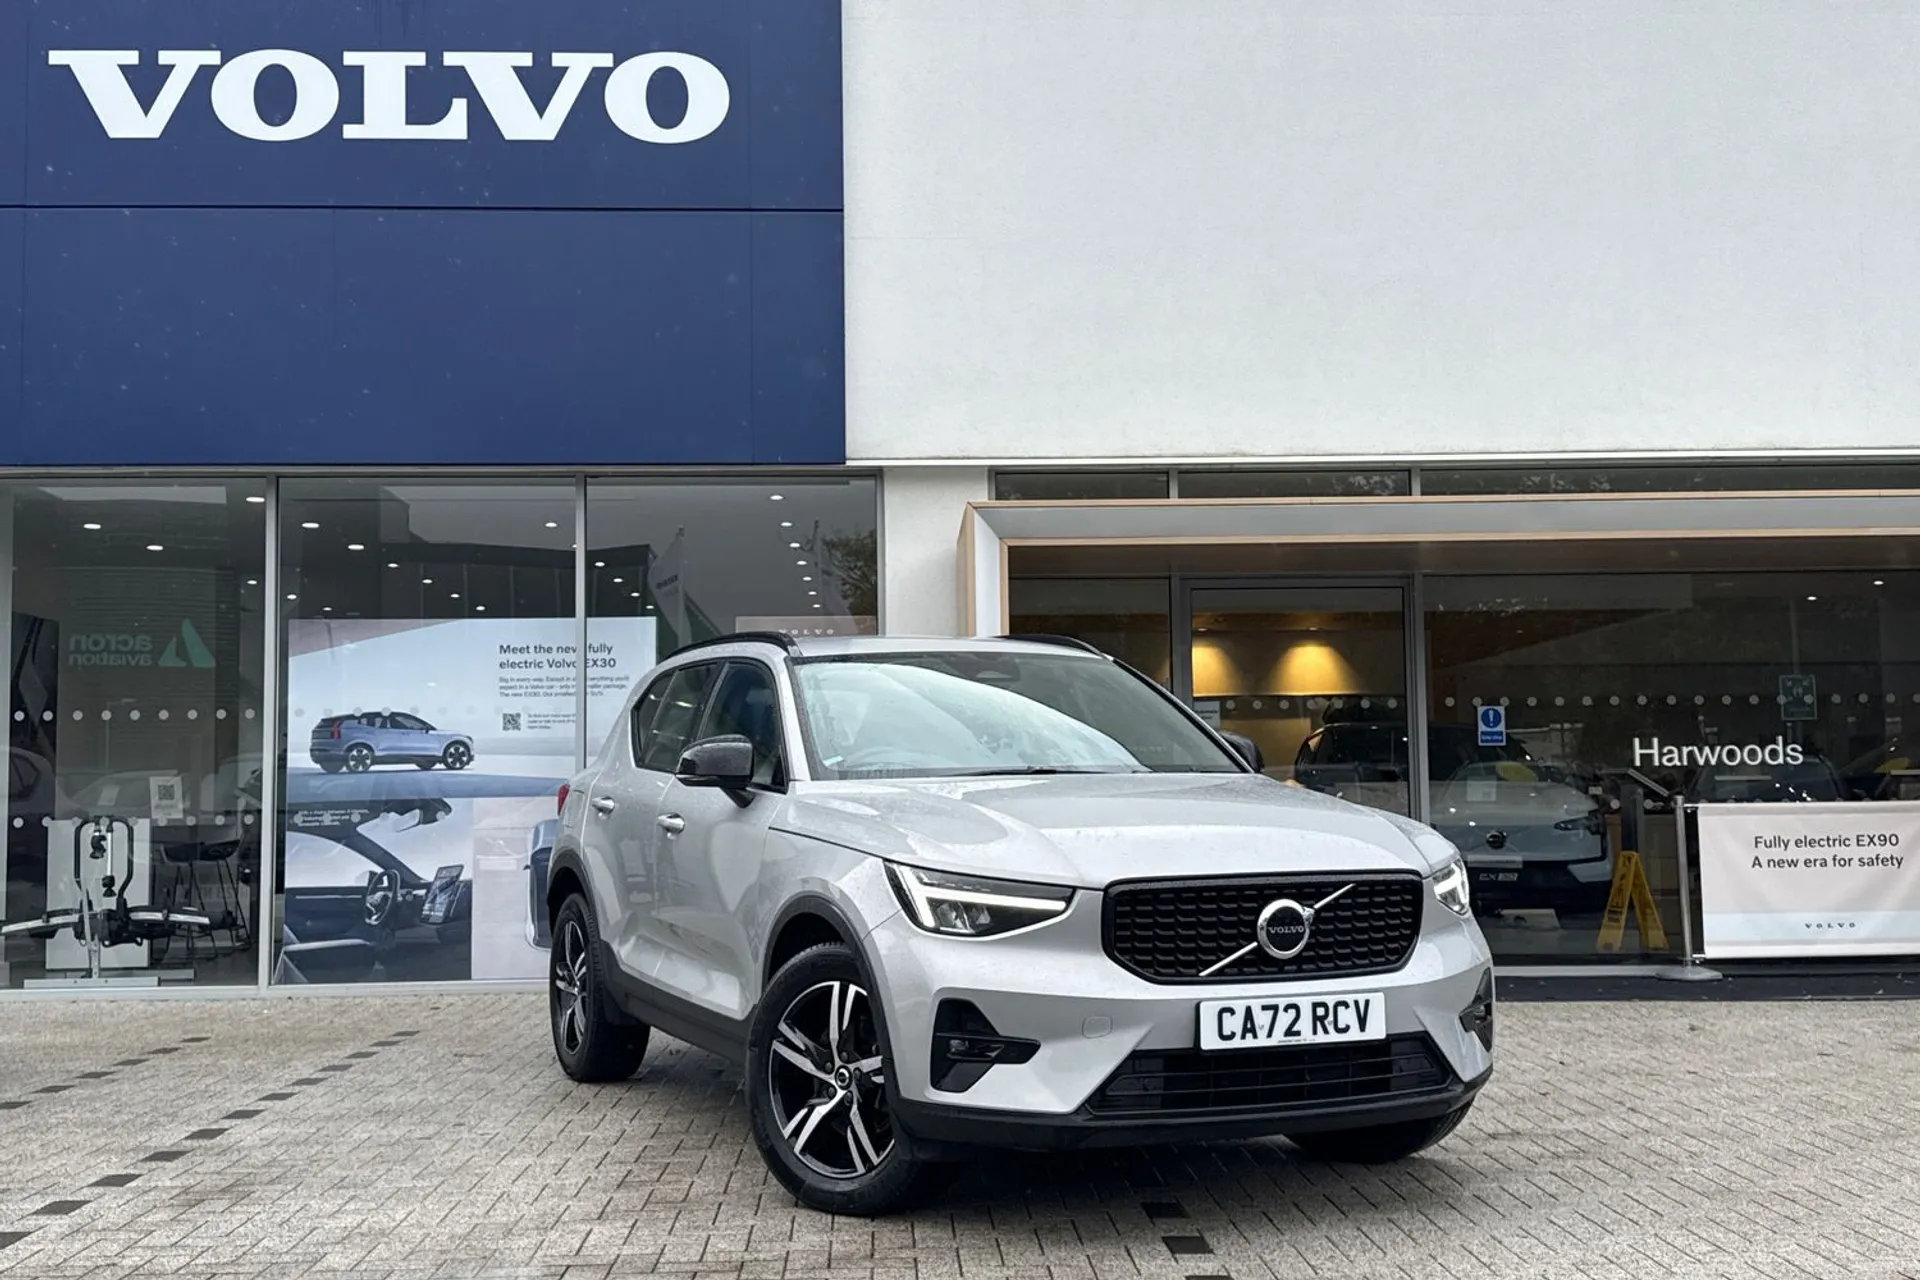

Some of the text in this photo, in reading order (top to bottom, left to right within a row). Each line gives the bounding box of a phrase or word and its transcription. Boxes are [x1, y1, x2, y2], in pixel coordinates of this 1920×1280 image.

[48, 49, 730, 144] VOLVO
[499, 644, 531, 654] Meet
[534, 644, 554, 654] the
[588, 643, 614, 655] fully
[499, 659, 544, 669] electric
[585, 658, 617, 668] EX30
[1632, 735, 1804, 767] Harwoods
[1754, 833, 1900, 851] Fully electric EX90
[1751, 854, 1904, 868] A new era for safety
[1267, 925, 1305, 934] VOLVO
[1216, 998, 1370, 1042] CA72 RCV
